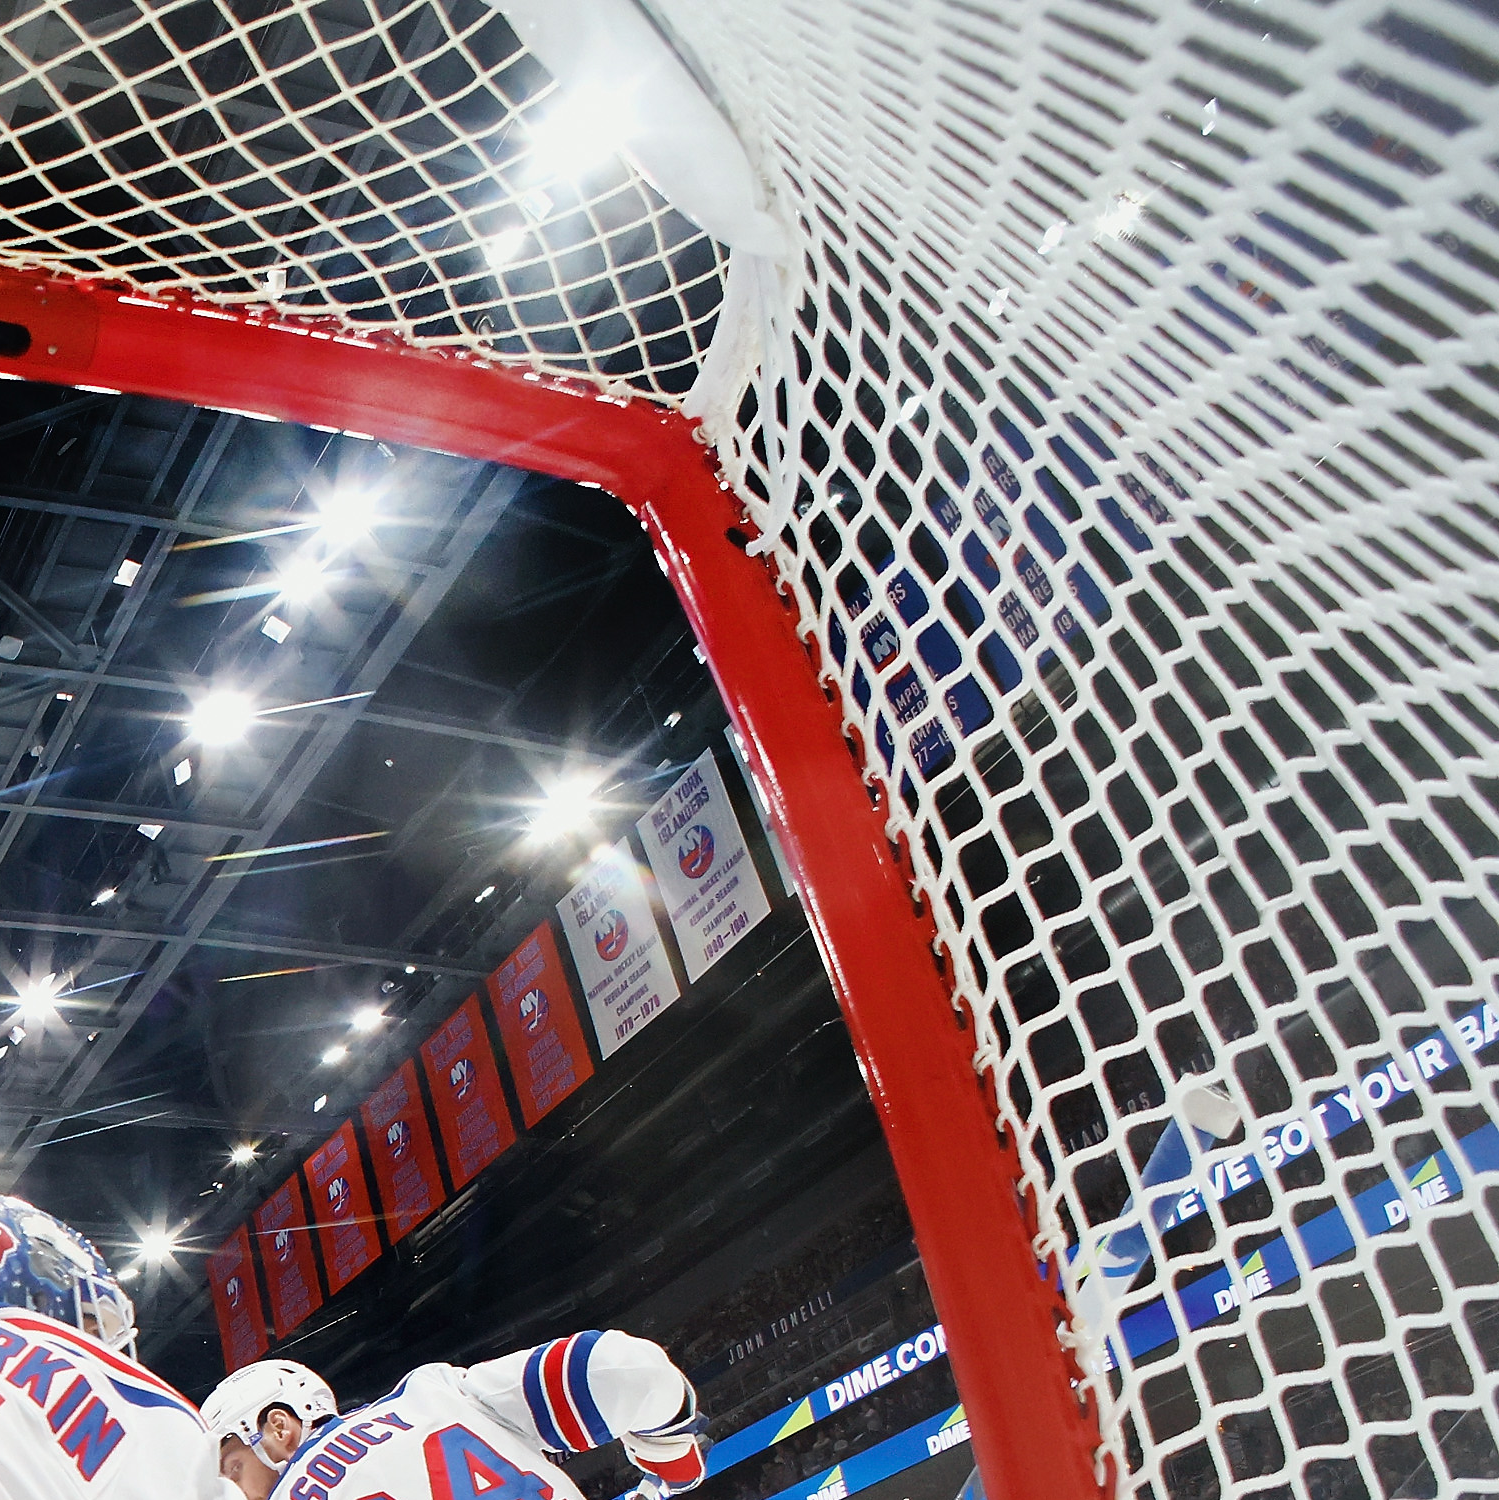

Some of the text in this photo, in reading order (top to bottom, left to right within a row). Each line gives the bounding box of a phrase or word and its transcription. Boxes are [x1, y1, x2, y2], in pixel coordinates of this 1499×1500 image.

[1332, 1038, 1449, 1125] YOUR
[728, 1336, 764, 1367] JOHN
[927, 1417, 972, 1457] DIME
